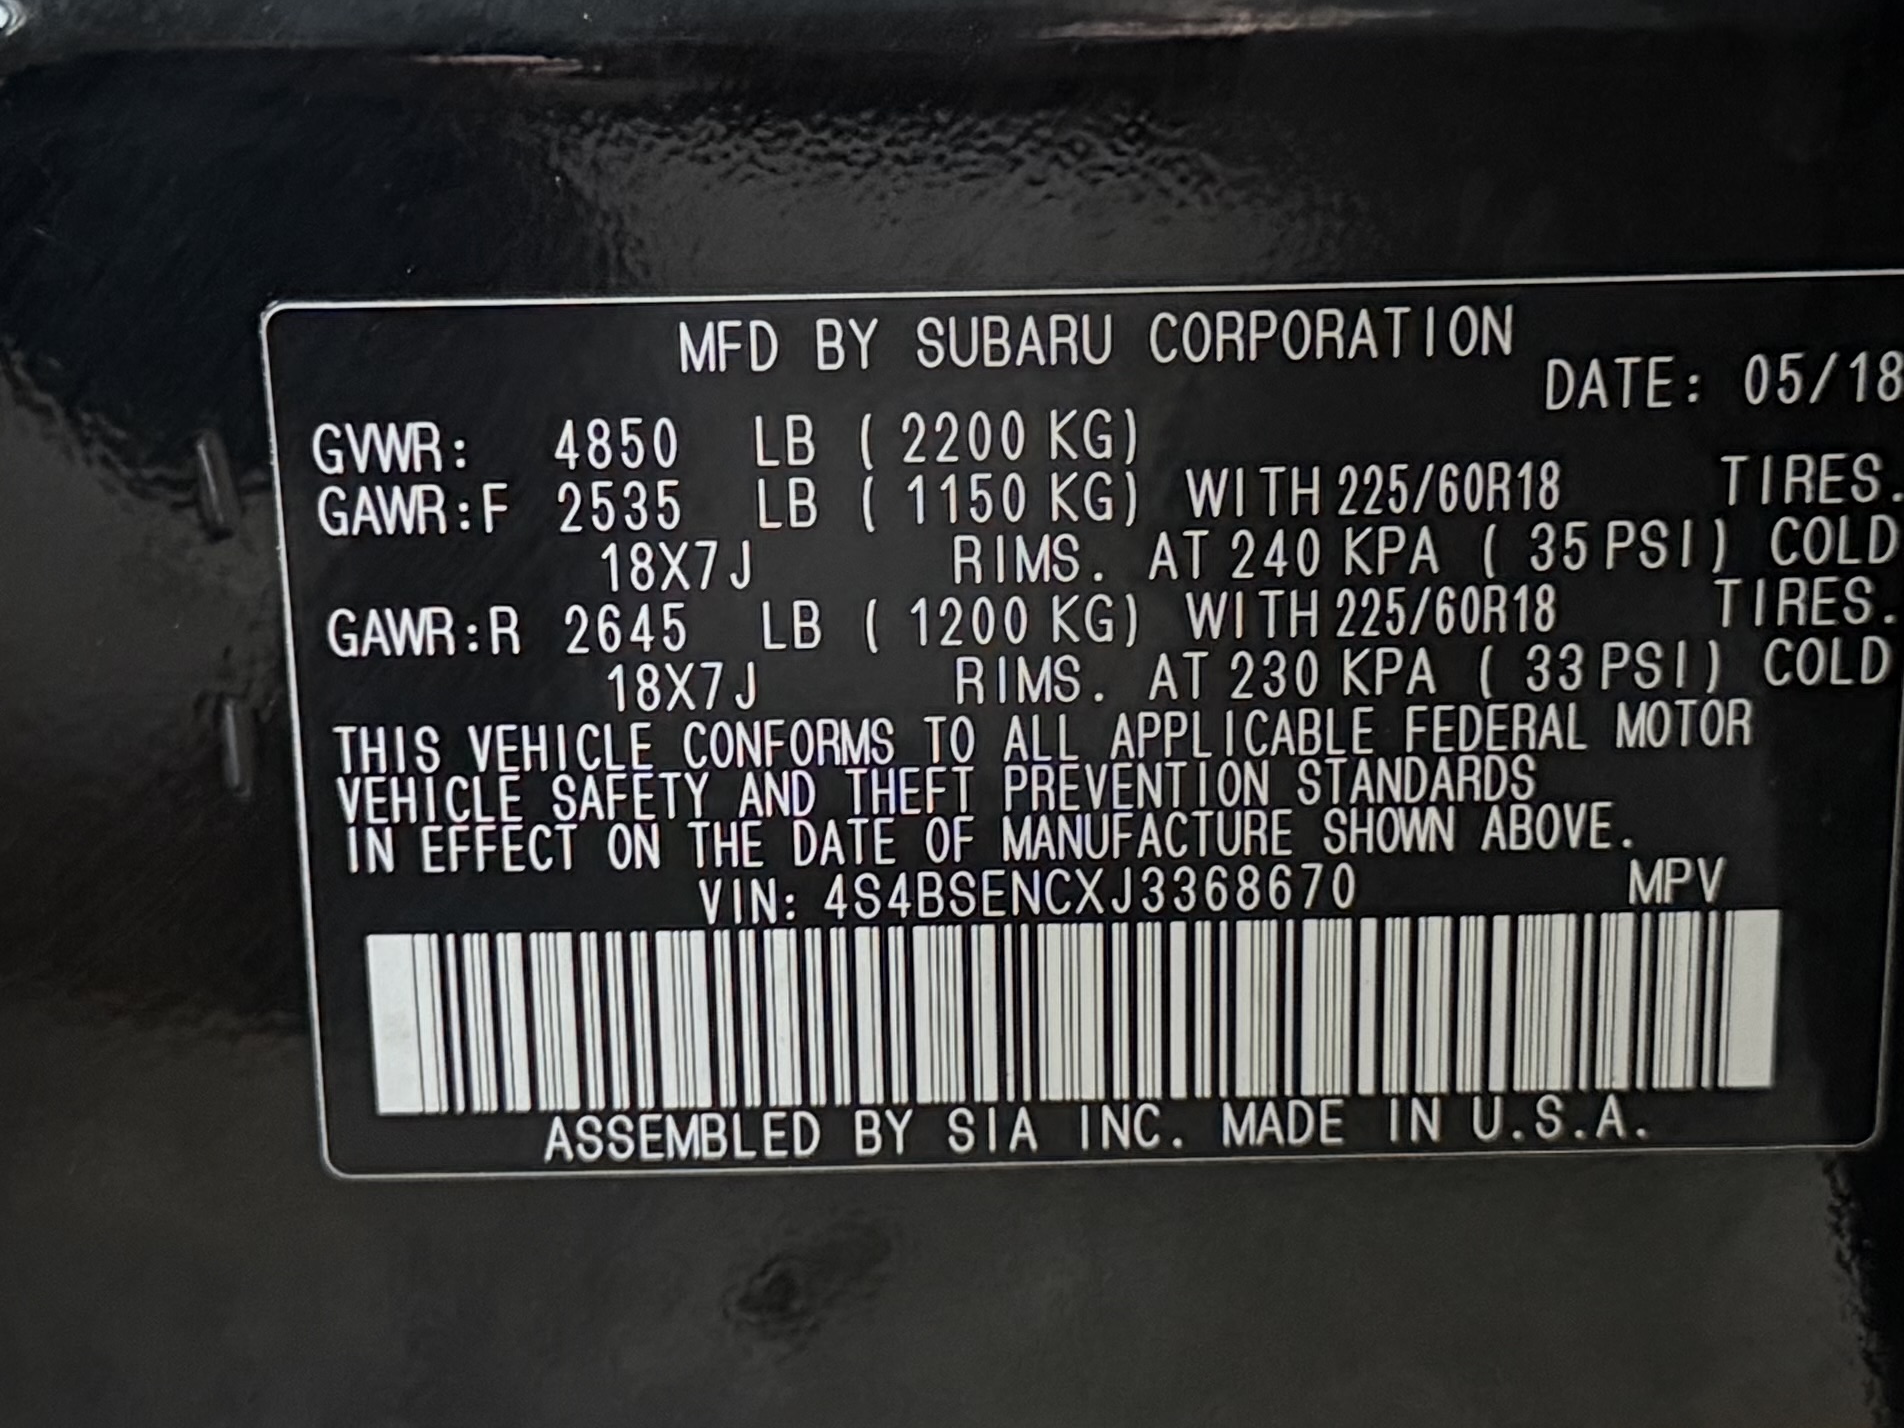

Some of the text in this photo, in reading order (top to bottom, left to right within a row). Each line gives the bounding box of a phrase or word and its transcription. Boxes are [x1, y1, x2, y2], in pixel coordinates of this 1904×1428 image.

[678, 304, 1513, 374] MFD BY SUBARU CORPORATION
[1546, 350, 1904, 411] DATE: 05/18
[312, 421, 466, 475] GVWR:
[554, 416, 678, 471] 4850
[754, 414, 816, 467] LB
[557, 479, 681, 533] 2535
[757, 476, 818, 529] LB
[1185, 466, 1320, 518] WITH
[1338, 460, 1560, 516] 225/60R18
[1720, 452, 1903, 506] TIRES.
[600, 539, 751, 593] 18X7J
[953, 533, 1103, 585] RIMS.
[1148, 529, 1210, 581] AT
[1231, 527, 1320, 579] 240
[1344, 525, 1439, 576] KPA
[1770, 514, 1898, 566] COLD
[564, 602, 687, 654] 2645
[762, 599, 822, 650] LB
[1185, 589, 1318, 640] WITH
[1336, 583, 1556, 638] 225/60R18
[1714, 575, 1894, 628] TIRES.
[607, 661, 756, 713] 18X7J
[956, 654, 1104, 705] RIMS.
[1148, 651, 1209, 701] AT
[1230, 649, 1319, 699] 230
[1343, 647, 1437, 696] KPA
[1764, 635, 1890, 686] COLD
[332, 697, 1753, 775] THIS VEHICLE CONFORMS TO ALL APPLICABLE FEDERAL MOTOR
[336, 753, 1536, 825] VEHICLE SAFETY AND THEFT PREVENTION STANDARDS
[347, 801, 1632, 874] IN EFFECT ON THE DATE OF MANUFACTURE SHOWN ABOVE.
[698, 862, 1356, 925] VIN: 4S4BSENCXJ3368670
[1628, 856, 1724, 905] MPV
[543, 1093, 1646, 1163] ASSEMBLED BY SIA INC. MADE IN U.S.A.
